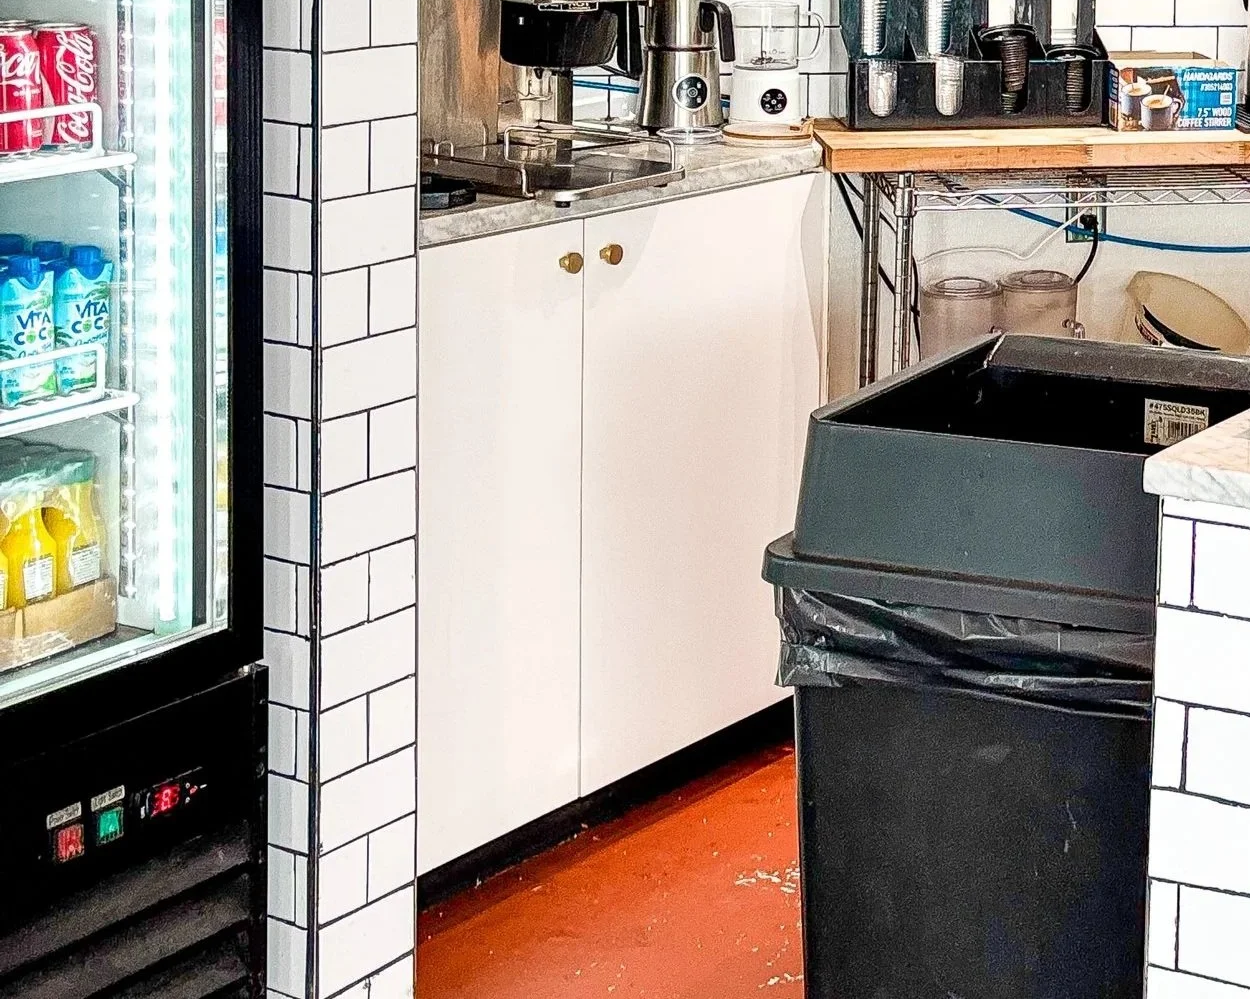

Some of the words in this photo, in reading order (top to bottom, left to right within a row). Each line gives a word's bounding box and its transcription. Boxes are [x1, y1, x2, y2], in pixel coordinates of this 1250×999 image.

[1211, 107, 1232, 117] WOOD
[1177, 118, 1203, 128] COFFEE
[75, 299, 109, 319] VITA
[16, 310, 51, 330] VITA
